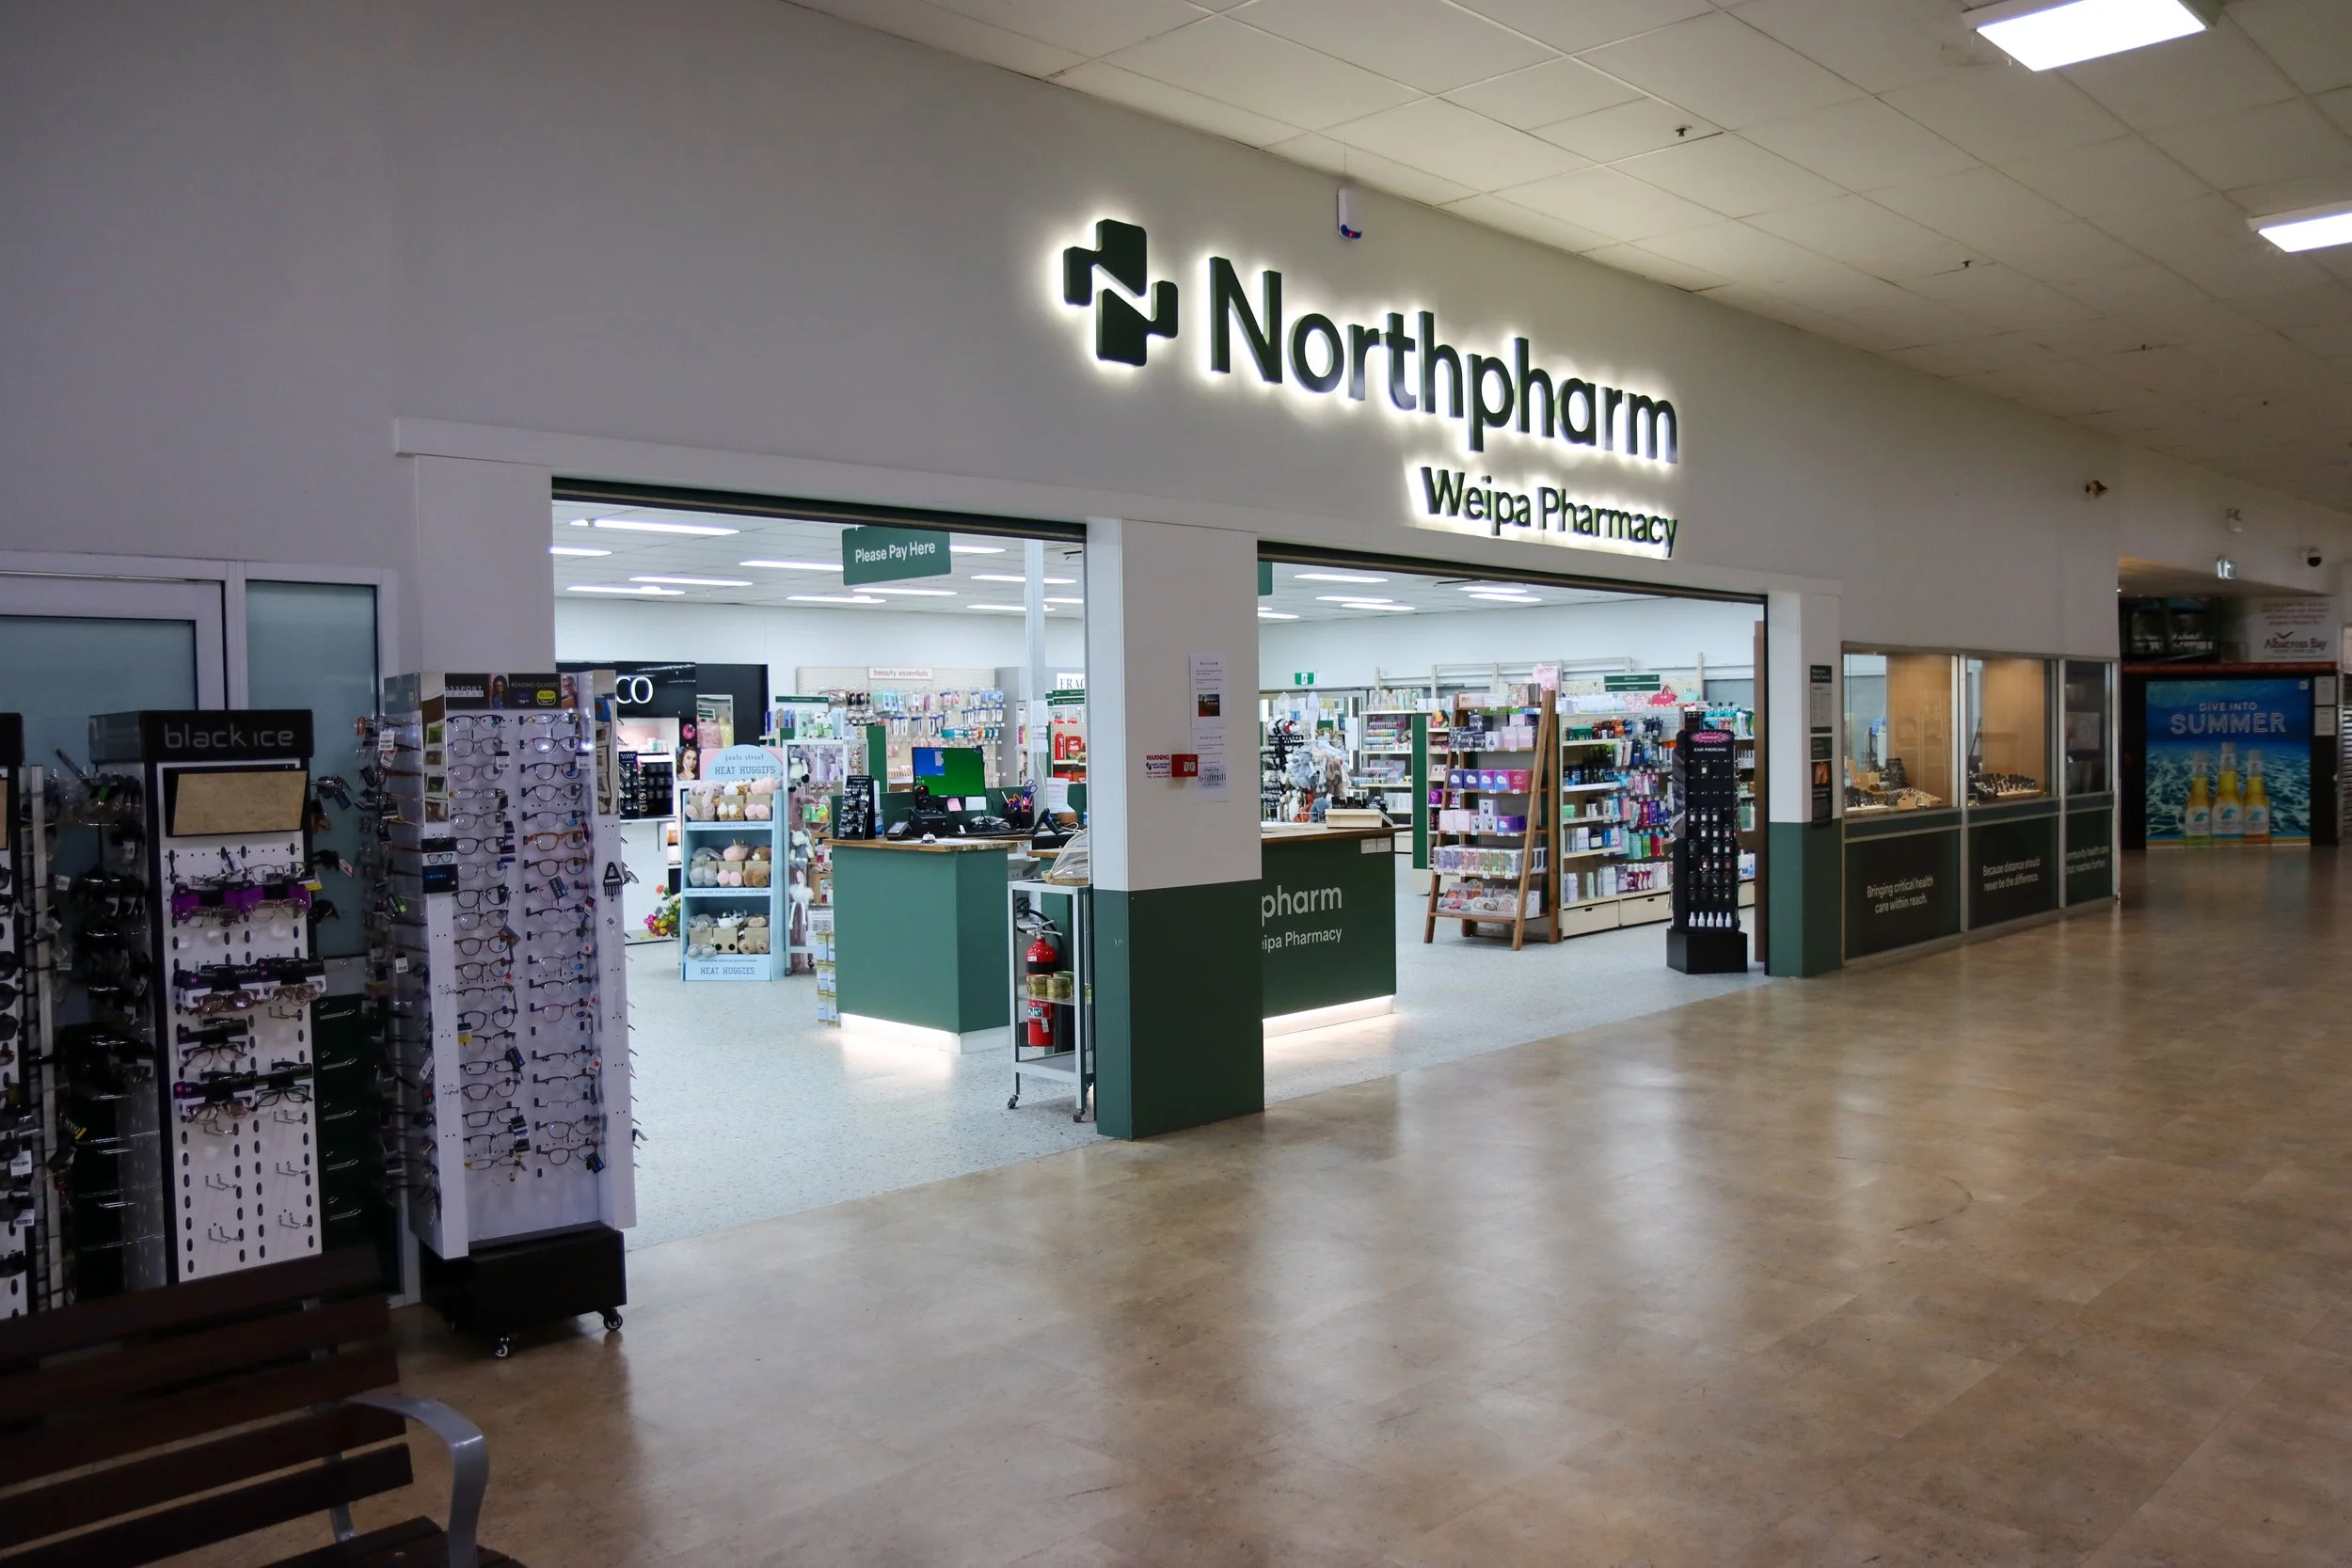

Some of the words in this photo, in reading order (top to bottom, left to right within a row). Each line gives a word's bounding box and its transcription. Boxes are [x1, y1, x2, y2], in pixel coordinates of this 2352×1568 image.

[1209, 256, 1677, 464] Northpharm
[1420, 467, 1531, 536] Weipa
[1537, 486, 1677, 558] Pharmacy
[855, 548, 887, 563] Please
[889, 545, 908, 561] Pay
[909, 541, 935, 556] Here
[873, 669, 897, 677] beauty
[2199, 703, 2226, 711] DIVE
[2230, 702, 2257, 710] INTO
[2169, 712, 2287, 735] SUMMER
[164, 722, 247, 749] black
[253, 730, 294, 746] ice
[715, 766, 737, 774] HEAT
[1982, 865, 2003, 877] Because
[2004, 861, 2024, 873] distance
[2025, 857, 2040, 868] should
[1867, 882, 1893, 898] Bringing
[1894, 878, 1915, 893] critical
[1915, 874, 1933, 889] health
[1983, 881, 1998, 892] never
[1998, 878, 2005, 889] be
[1874, 902, 1889, 914] care
[1889, 895, 1909, 911] within
[1285, 928, 1342, 946] Pharmacy
[700, 966, 719, 974] HEAT
[723, 966, 755, 974] HUGGIES
